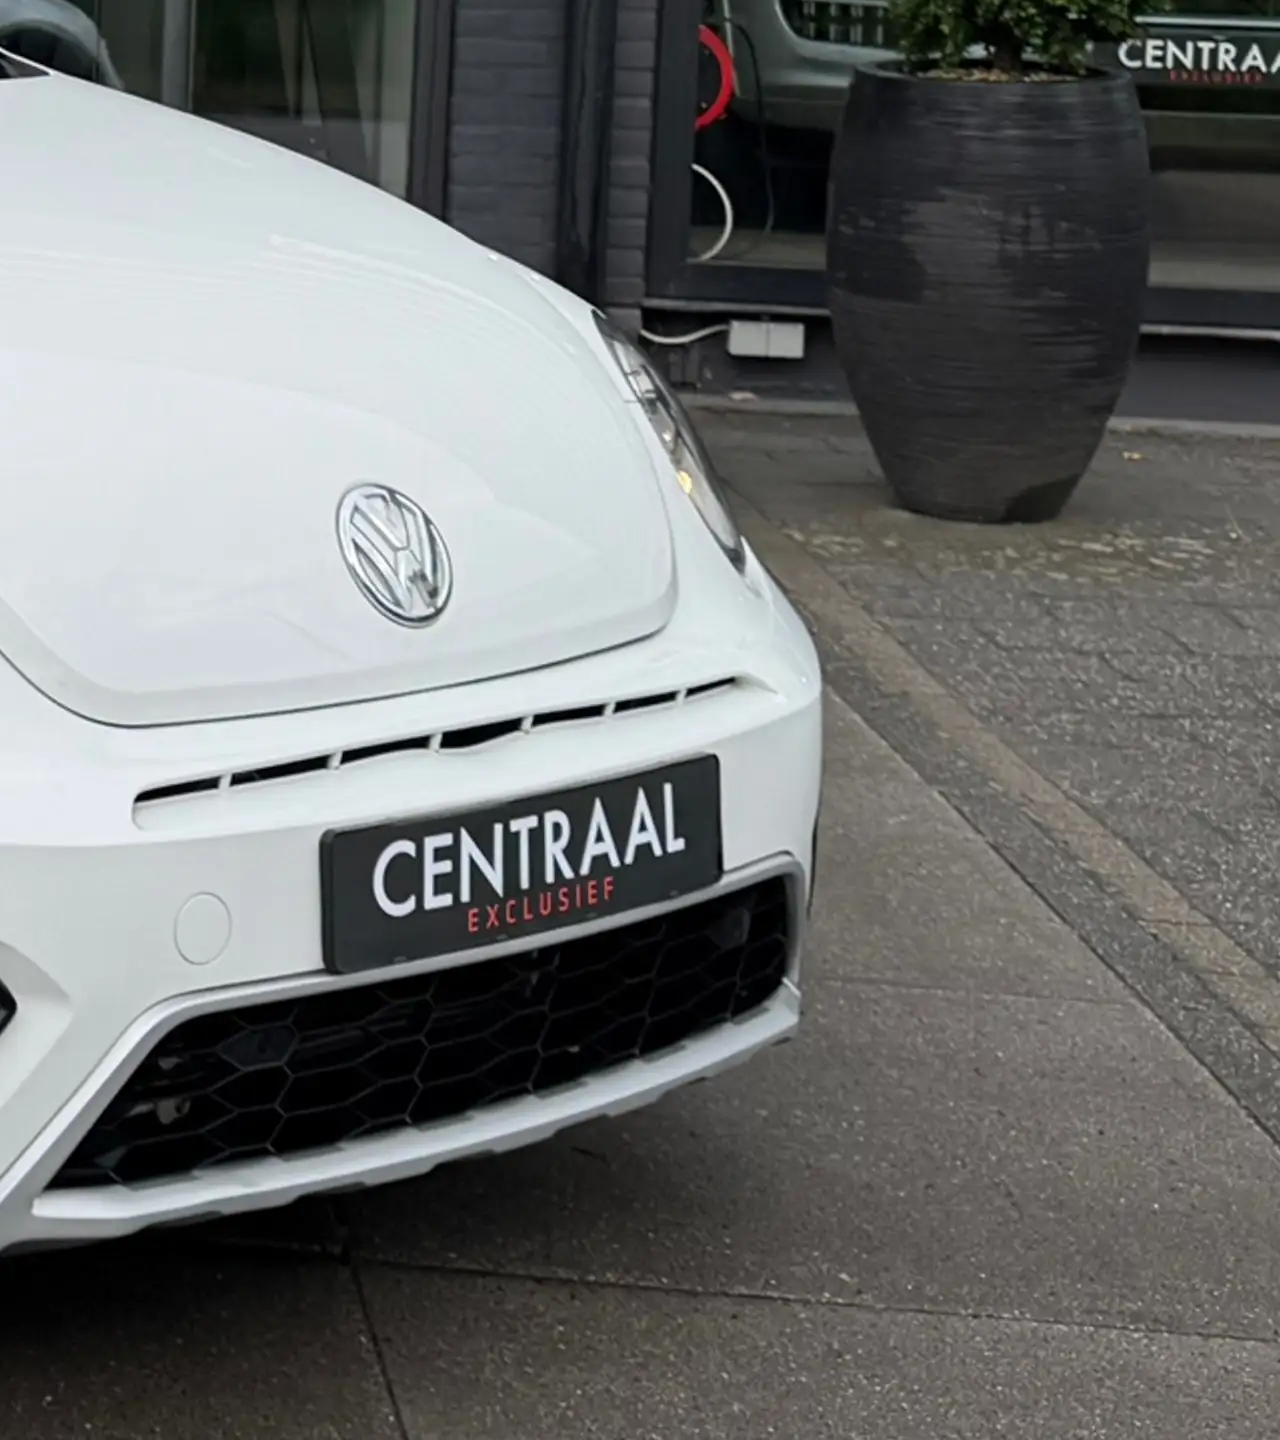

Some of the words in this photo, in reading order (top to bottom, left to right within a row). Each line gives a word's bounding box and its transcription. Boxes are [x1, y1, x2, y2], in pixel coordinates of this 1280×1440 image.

[1117, 38, 1280, 74] CENTRA
[372, 783, 685, 918] CENTRAAL
[467, 875, 616, 932] EXCLUSIEF
